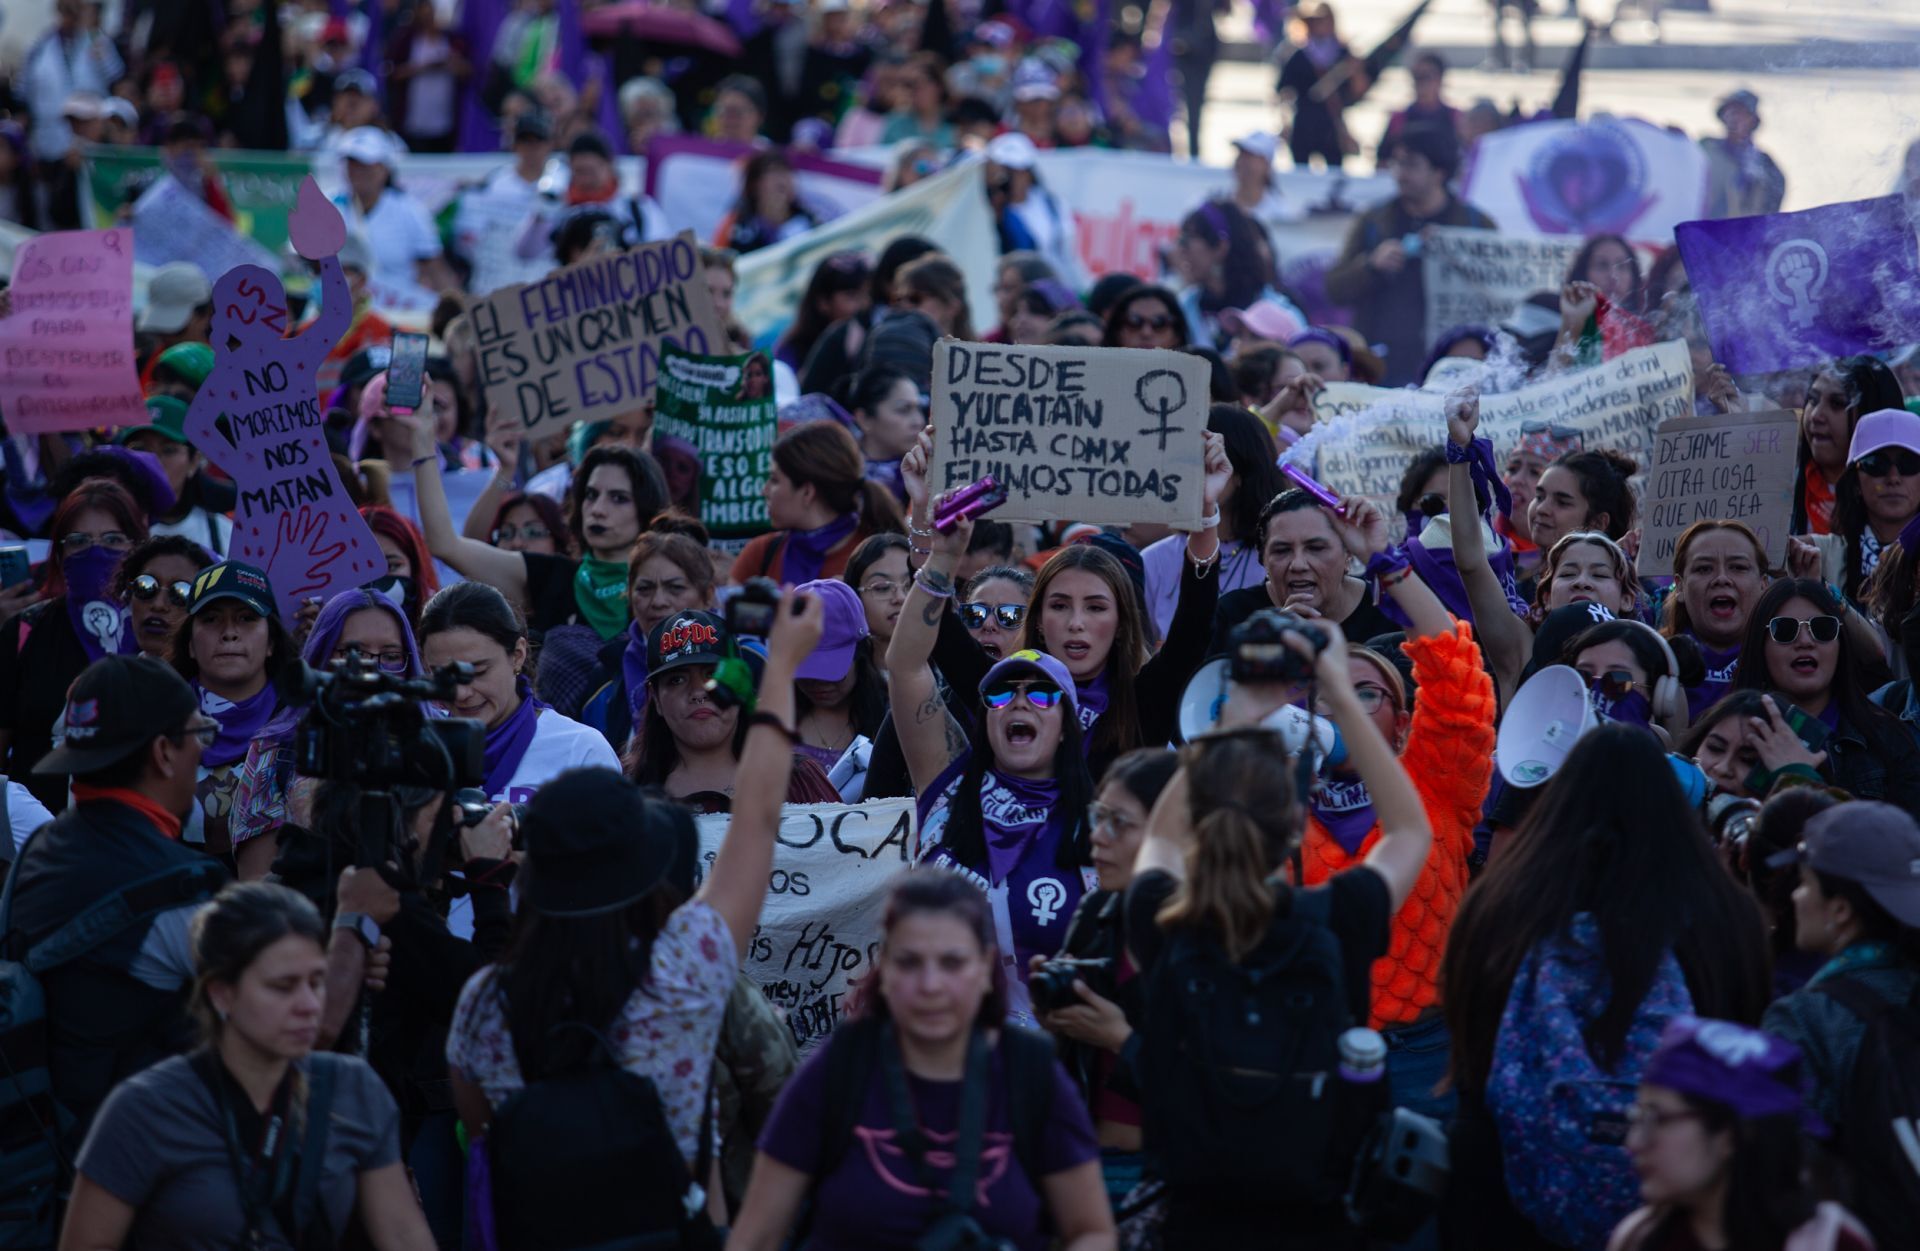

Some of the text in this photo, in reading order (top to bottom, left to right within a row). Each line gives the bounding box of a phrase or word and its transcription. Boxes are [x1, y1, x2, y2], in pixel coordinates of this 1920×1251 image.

[472, 239, 696, 345] EL FEMINICIDIO
[31, 318, 86, 336] PARA
[481, 284, 691, 386] ES UN CRIMEN
[244, 361, 289, 396] NO
[516, 325, 709, 427] DE ESTAO
[948, 346, 1086, 392] DESDE
[233, 398, 321, 441] MORIMOS
[950, 391, 1103, 430] YUCATÁN
[1602, 404, 1661, 436] MUNDO
[265, 439, 309, 470] NOS
[950, 424, 1131, 465] HASTA CDMX
[1658, 431, 1732, 465] DÉJAME
[1744, 428, 1781, 455] SER
[707, 454, 749, 478] ESO
[1078, 466, 1182, 503] TODAS
[1657, 463, 1756, 500] OTRA COSA
[241, 468, 333, 518] MATAN
[712, 476, 766, 500] ALGO
[1652, 492, 1763, 528] QUE NO SEA
